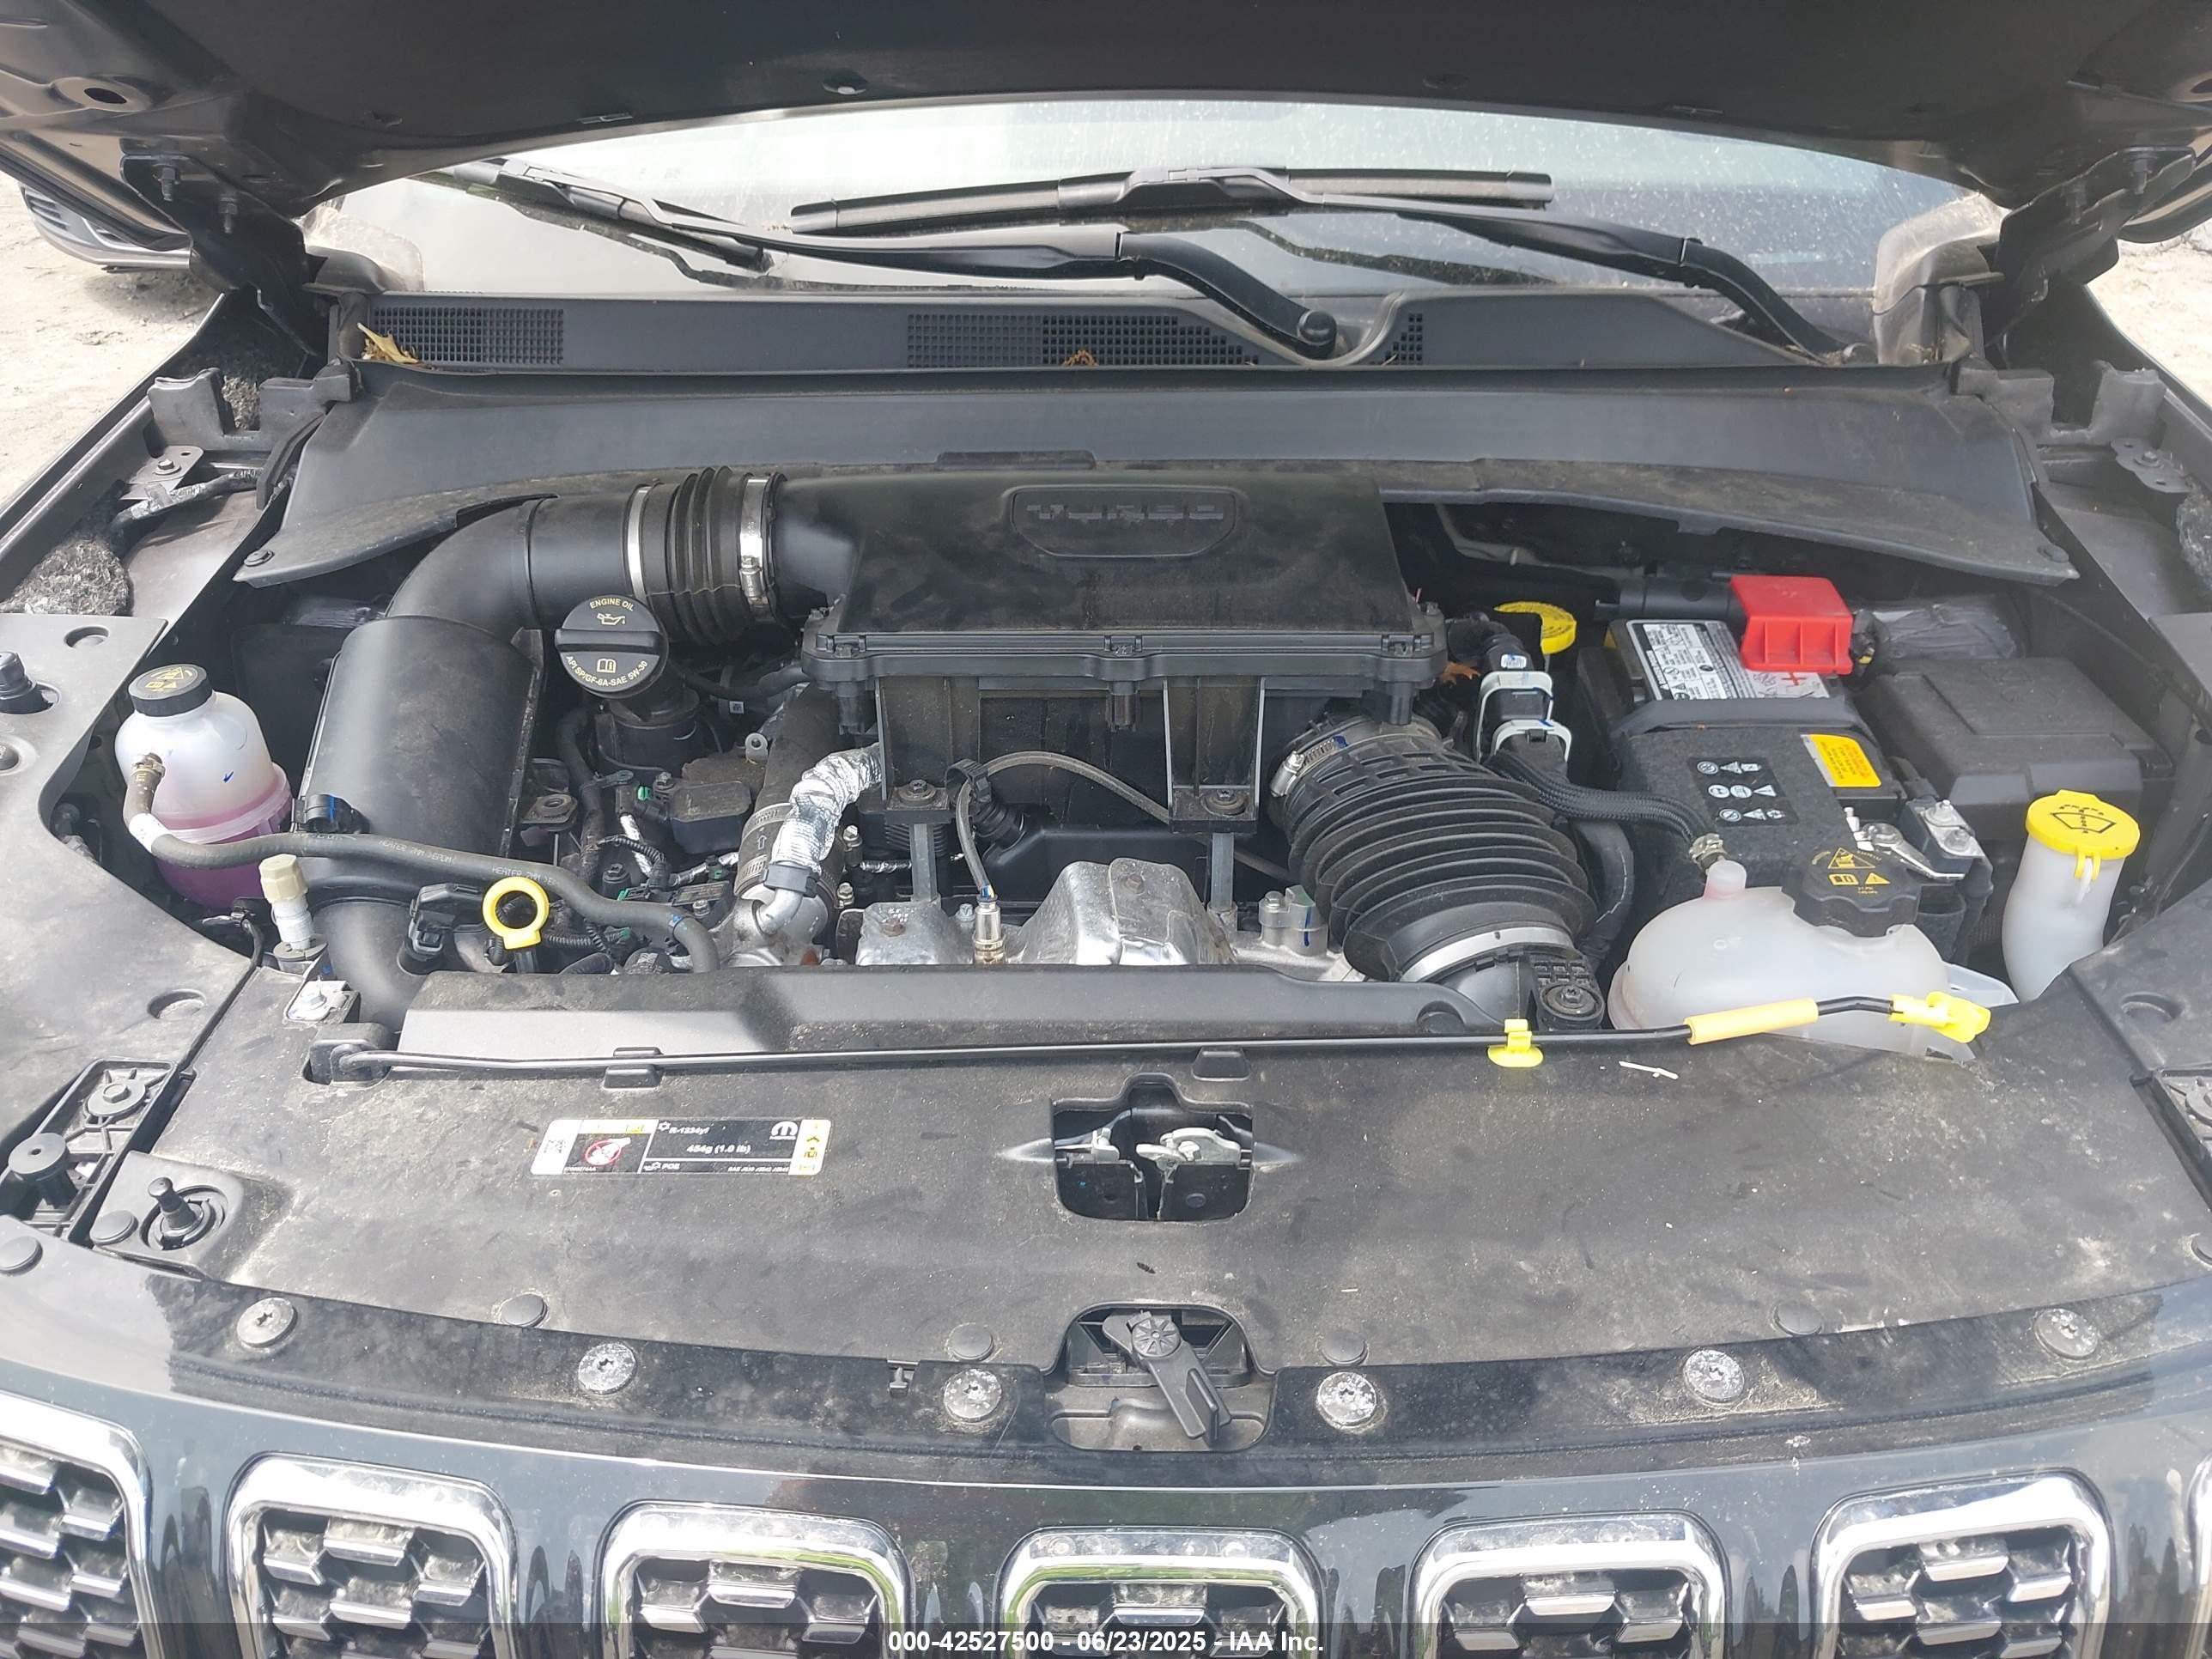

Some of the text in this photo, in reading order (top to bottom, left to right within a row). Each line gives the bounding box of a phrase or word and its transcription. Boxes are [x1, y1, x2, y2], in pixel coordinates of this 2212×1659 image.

[589, 598, 634, 611] ENGINE OIL
[567, 656, 578, 668] API
[628, 660, 647, 680] 5W-30
[491, 866, 523, 877] HEATER
